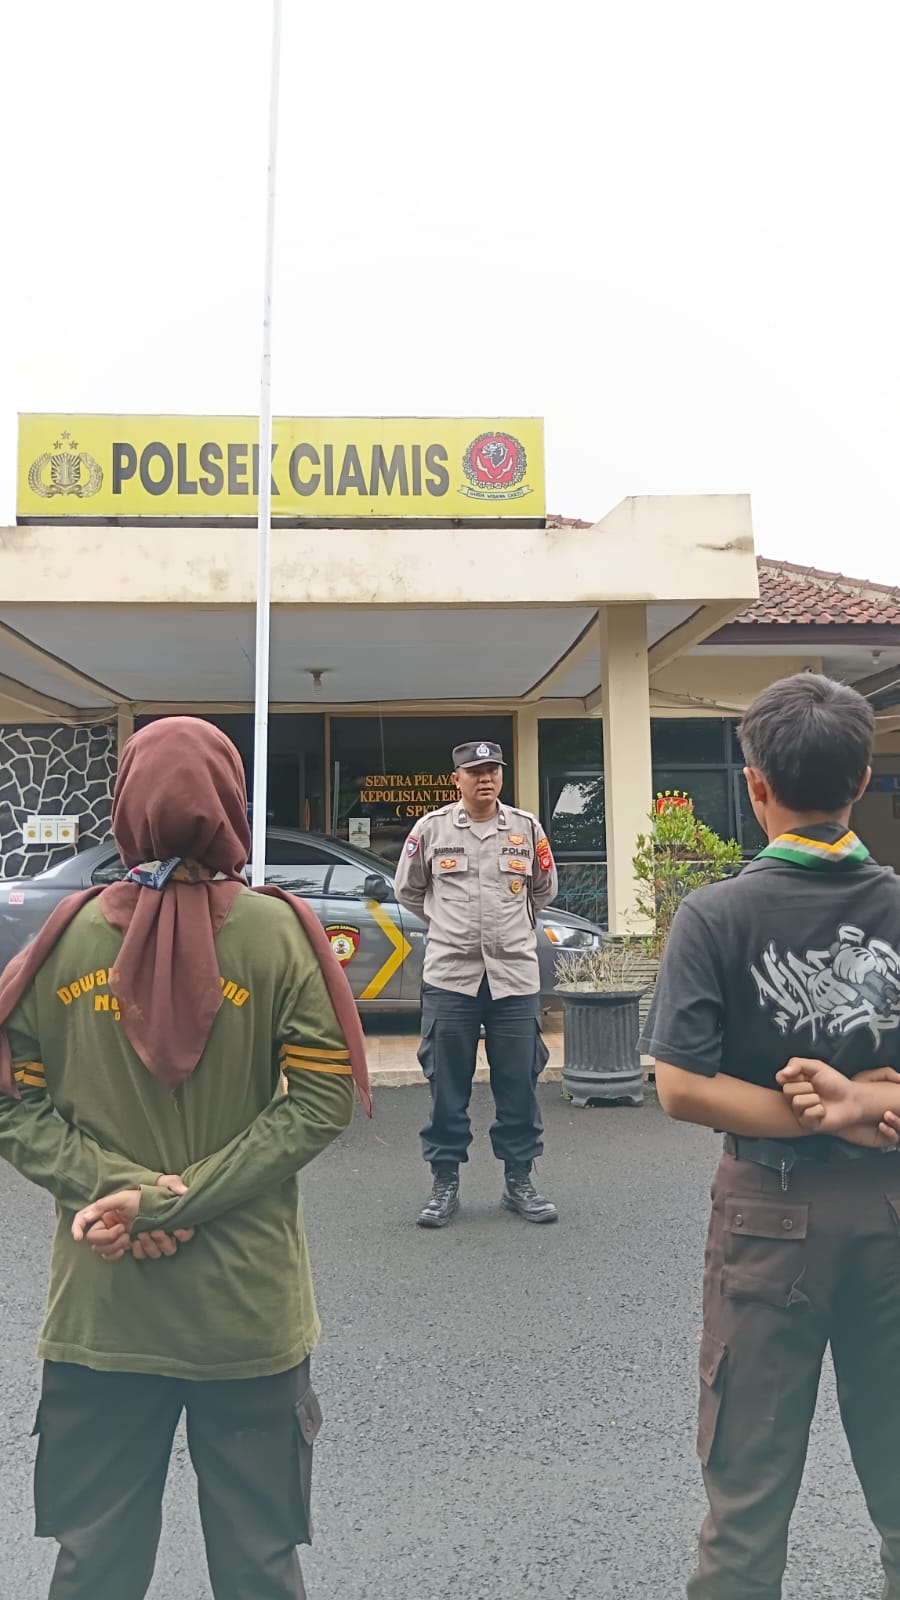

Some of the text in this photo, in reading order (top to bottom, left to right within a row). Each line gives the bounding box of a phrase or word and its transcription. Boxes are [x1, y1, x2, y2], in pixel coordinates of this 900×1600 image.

[112, 441, 450, 497] POLSEK CIAMIS
[365, 775, 412, 787] SENTRA
[360, 790, 431, 803] KEPOLISIAN
[656, 789, 688, 799] SPKT
[502, 847, 530, 857] POLRI
